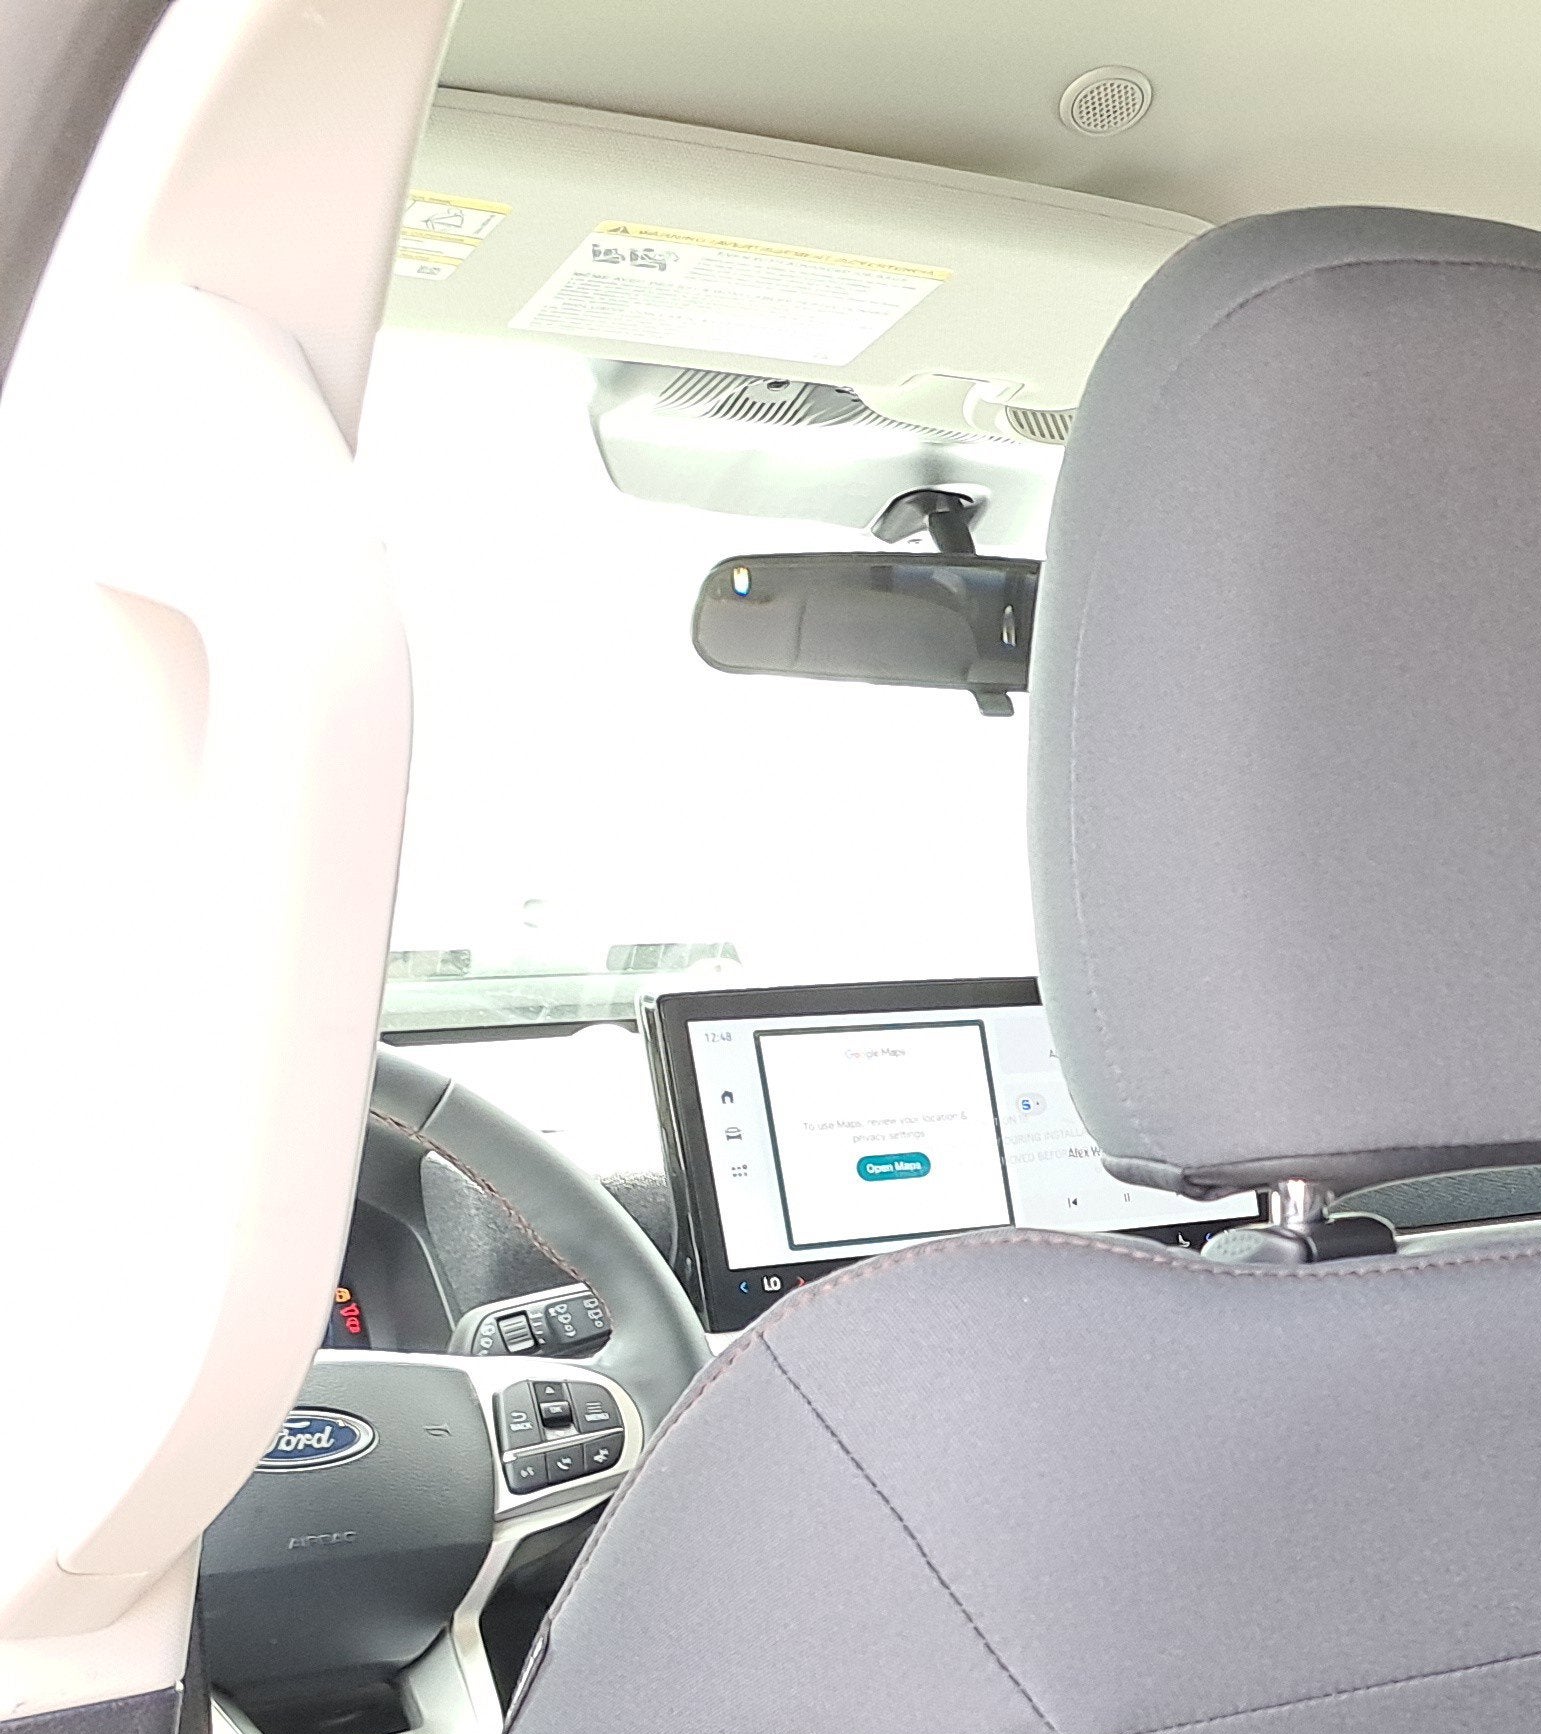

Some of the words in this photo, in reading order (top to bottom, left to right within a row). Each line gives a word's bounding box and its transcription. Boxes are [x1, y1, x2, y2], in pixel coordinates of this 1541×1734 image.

[844, 1048, 878, 1060] Gogle
[866, 1161, 893, 1174] Open
[895, 1159, 922, 1172] Maps
